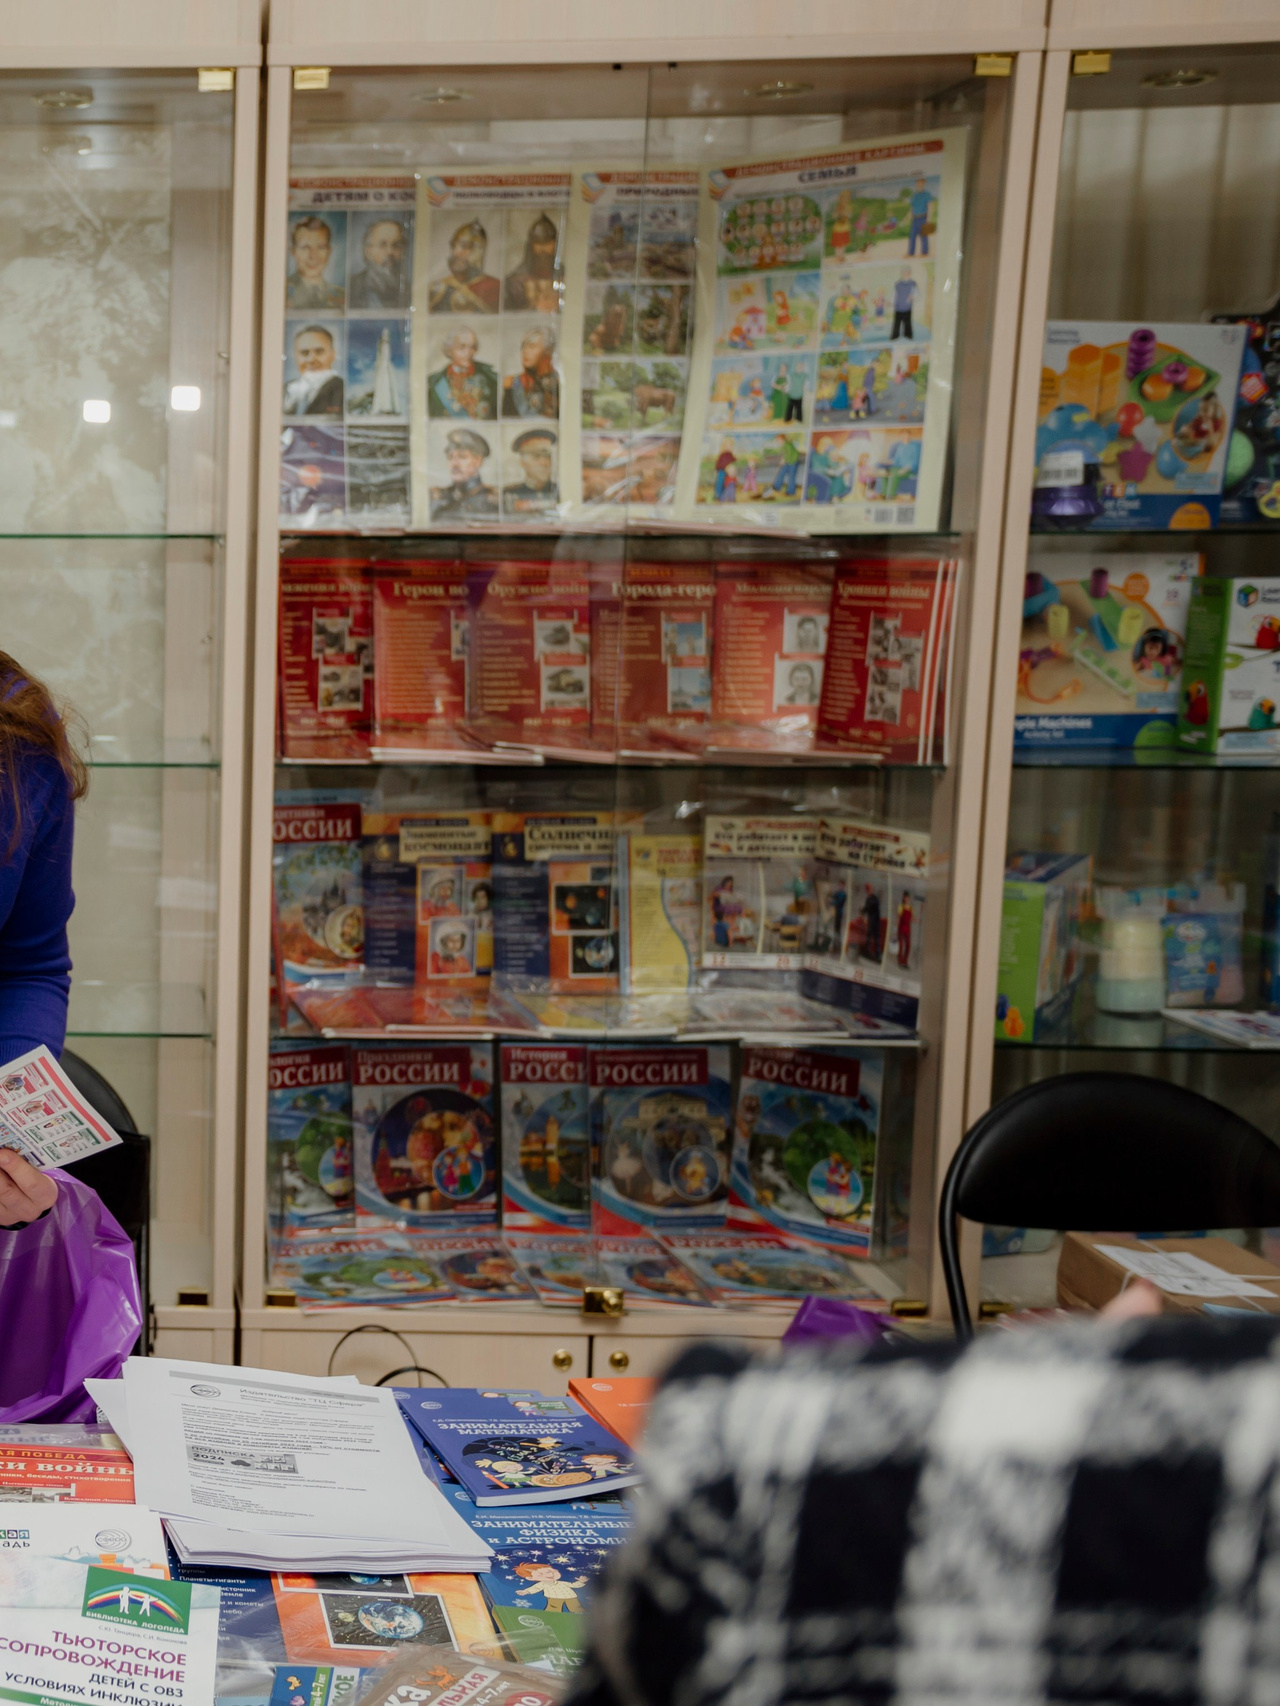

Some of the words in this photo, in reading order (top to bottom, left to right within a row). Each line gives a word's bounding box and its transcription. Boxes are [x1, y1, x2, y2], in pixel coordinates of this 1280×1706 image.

[797, 165, 857, 183] СЕМЬЯ
[393, 581, 445, 596] Герои
[449, 583, 469, 596] во
[611, 582, 716, 599] Города-геро
[273, 818, 353, 841] ОССИИ
[510, 1049, 567, 1062] История
[270, 1062, 344, 1087] ОССИИ
[358, 1062, 460, 1084] РОССИИ
[595, 1061, 699, 1084] РОССИИ
[748, 1056, 849, 1094] РОССИИ
[239, 1388, 306, 1402] Издательство
[437, 1422, 584, 1430] ЗАНИМАТЕЛЬНАЯ
[20, 1450, 87, 1460] ПОБЕДА
[191, 1445, 256, 1458] ПОДПИСКА
[192, 1452, 226, 1461] 2024
[26, 1472, 62, 1481] беседы,
[64, 1474, 132, 1483] стихотворения
[505, 1537, 633, 1545] АСТРОНОМИ
[519, 1529, 599, 1537] ФИЗИКА
[179, 1575, 246, 1584] Планеты-гиганты
[85, 1611, 138, 1626] БИБЛИОТЕКА
[141, 1621, 186, 1635] ЛОГОПЕДА
[52, 1630, 187, 1666] ТЬЮТОРСКОЕ
[5, 1671, 86, 1696] УСЛОВИЯХ
[88, 1673, 135, 1690] ДЕТЕЙ
[140, 1683, 150, 1692] С
[154, 1685, 184, 1698] ОВЗ
